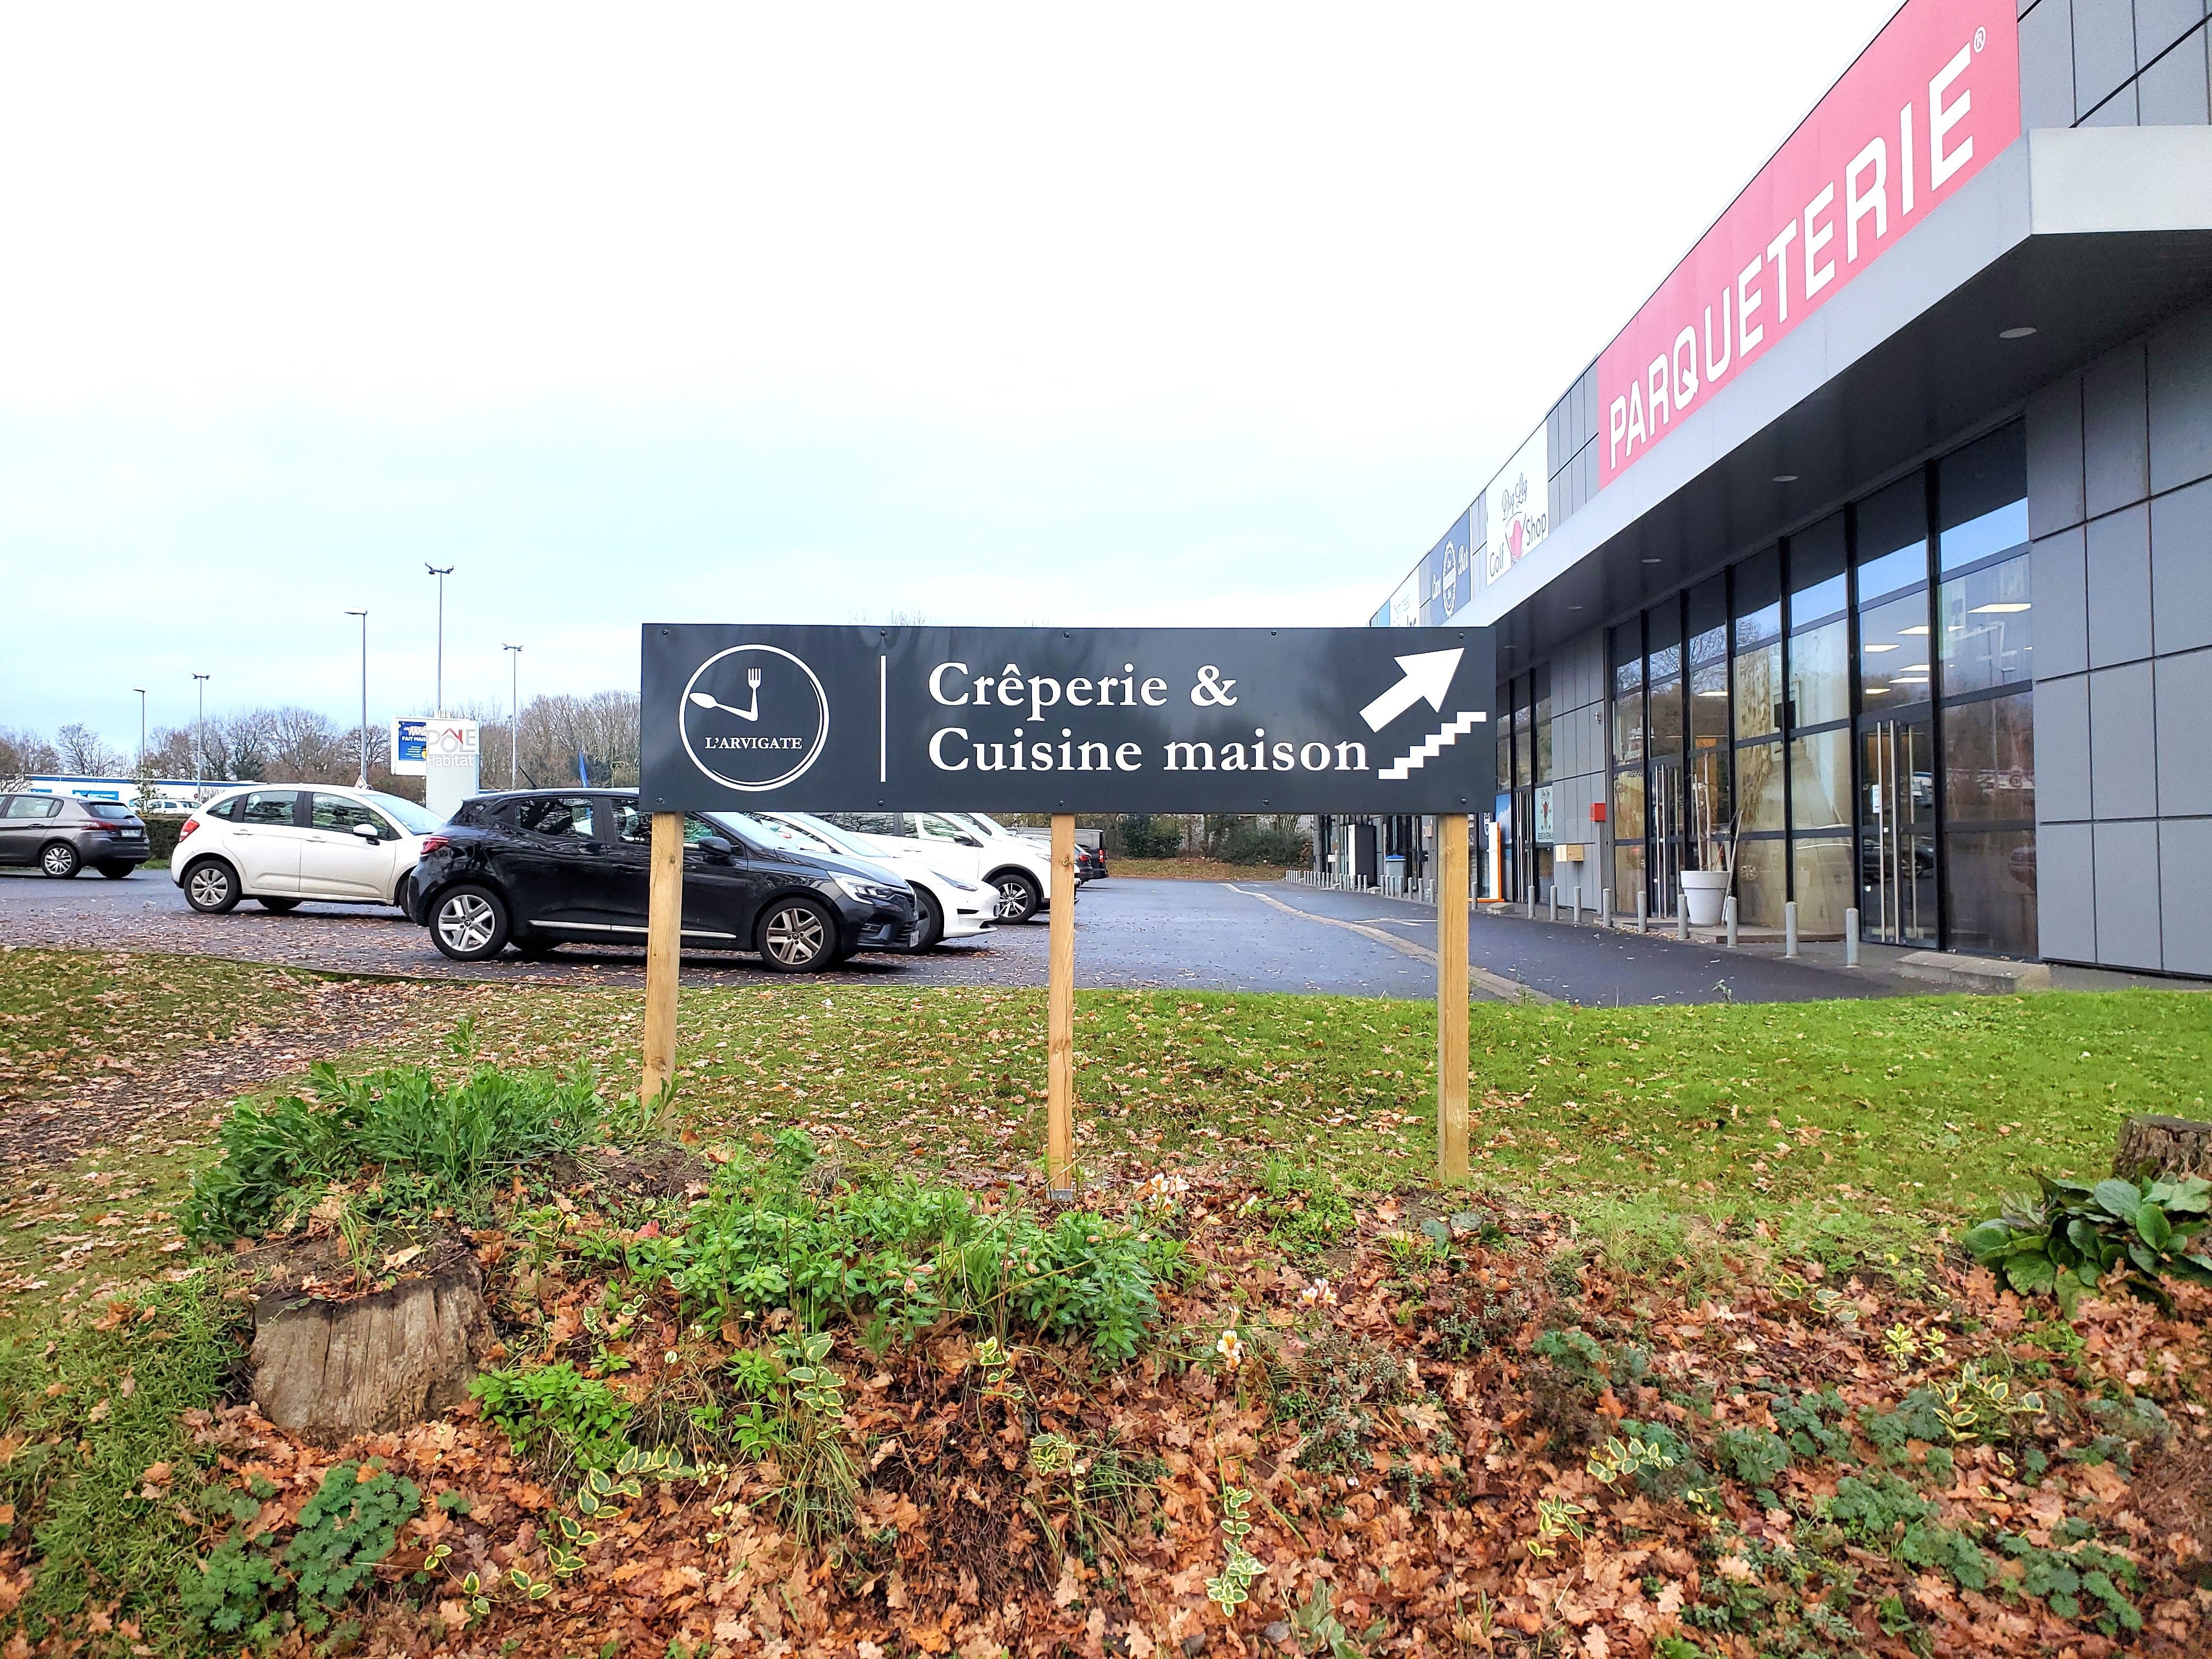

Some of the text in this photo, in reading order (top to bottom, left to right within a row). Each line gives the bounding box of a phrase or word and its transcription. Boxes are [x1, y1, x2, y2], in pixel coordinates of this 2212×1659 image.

[1489, 513, 1547, 577] Golf Shop
[929, 663, 1237, 721] Crêperie &
[427, 754, 475, 766] Habitat
[705, 737, 802, 749] L'ARVIGATE
[929, 727, 1369, 771] Cuisine maison
